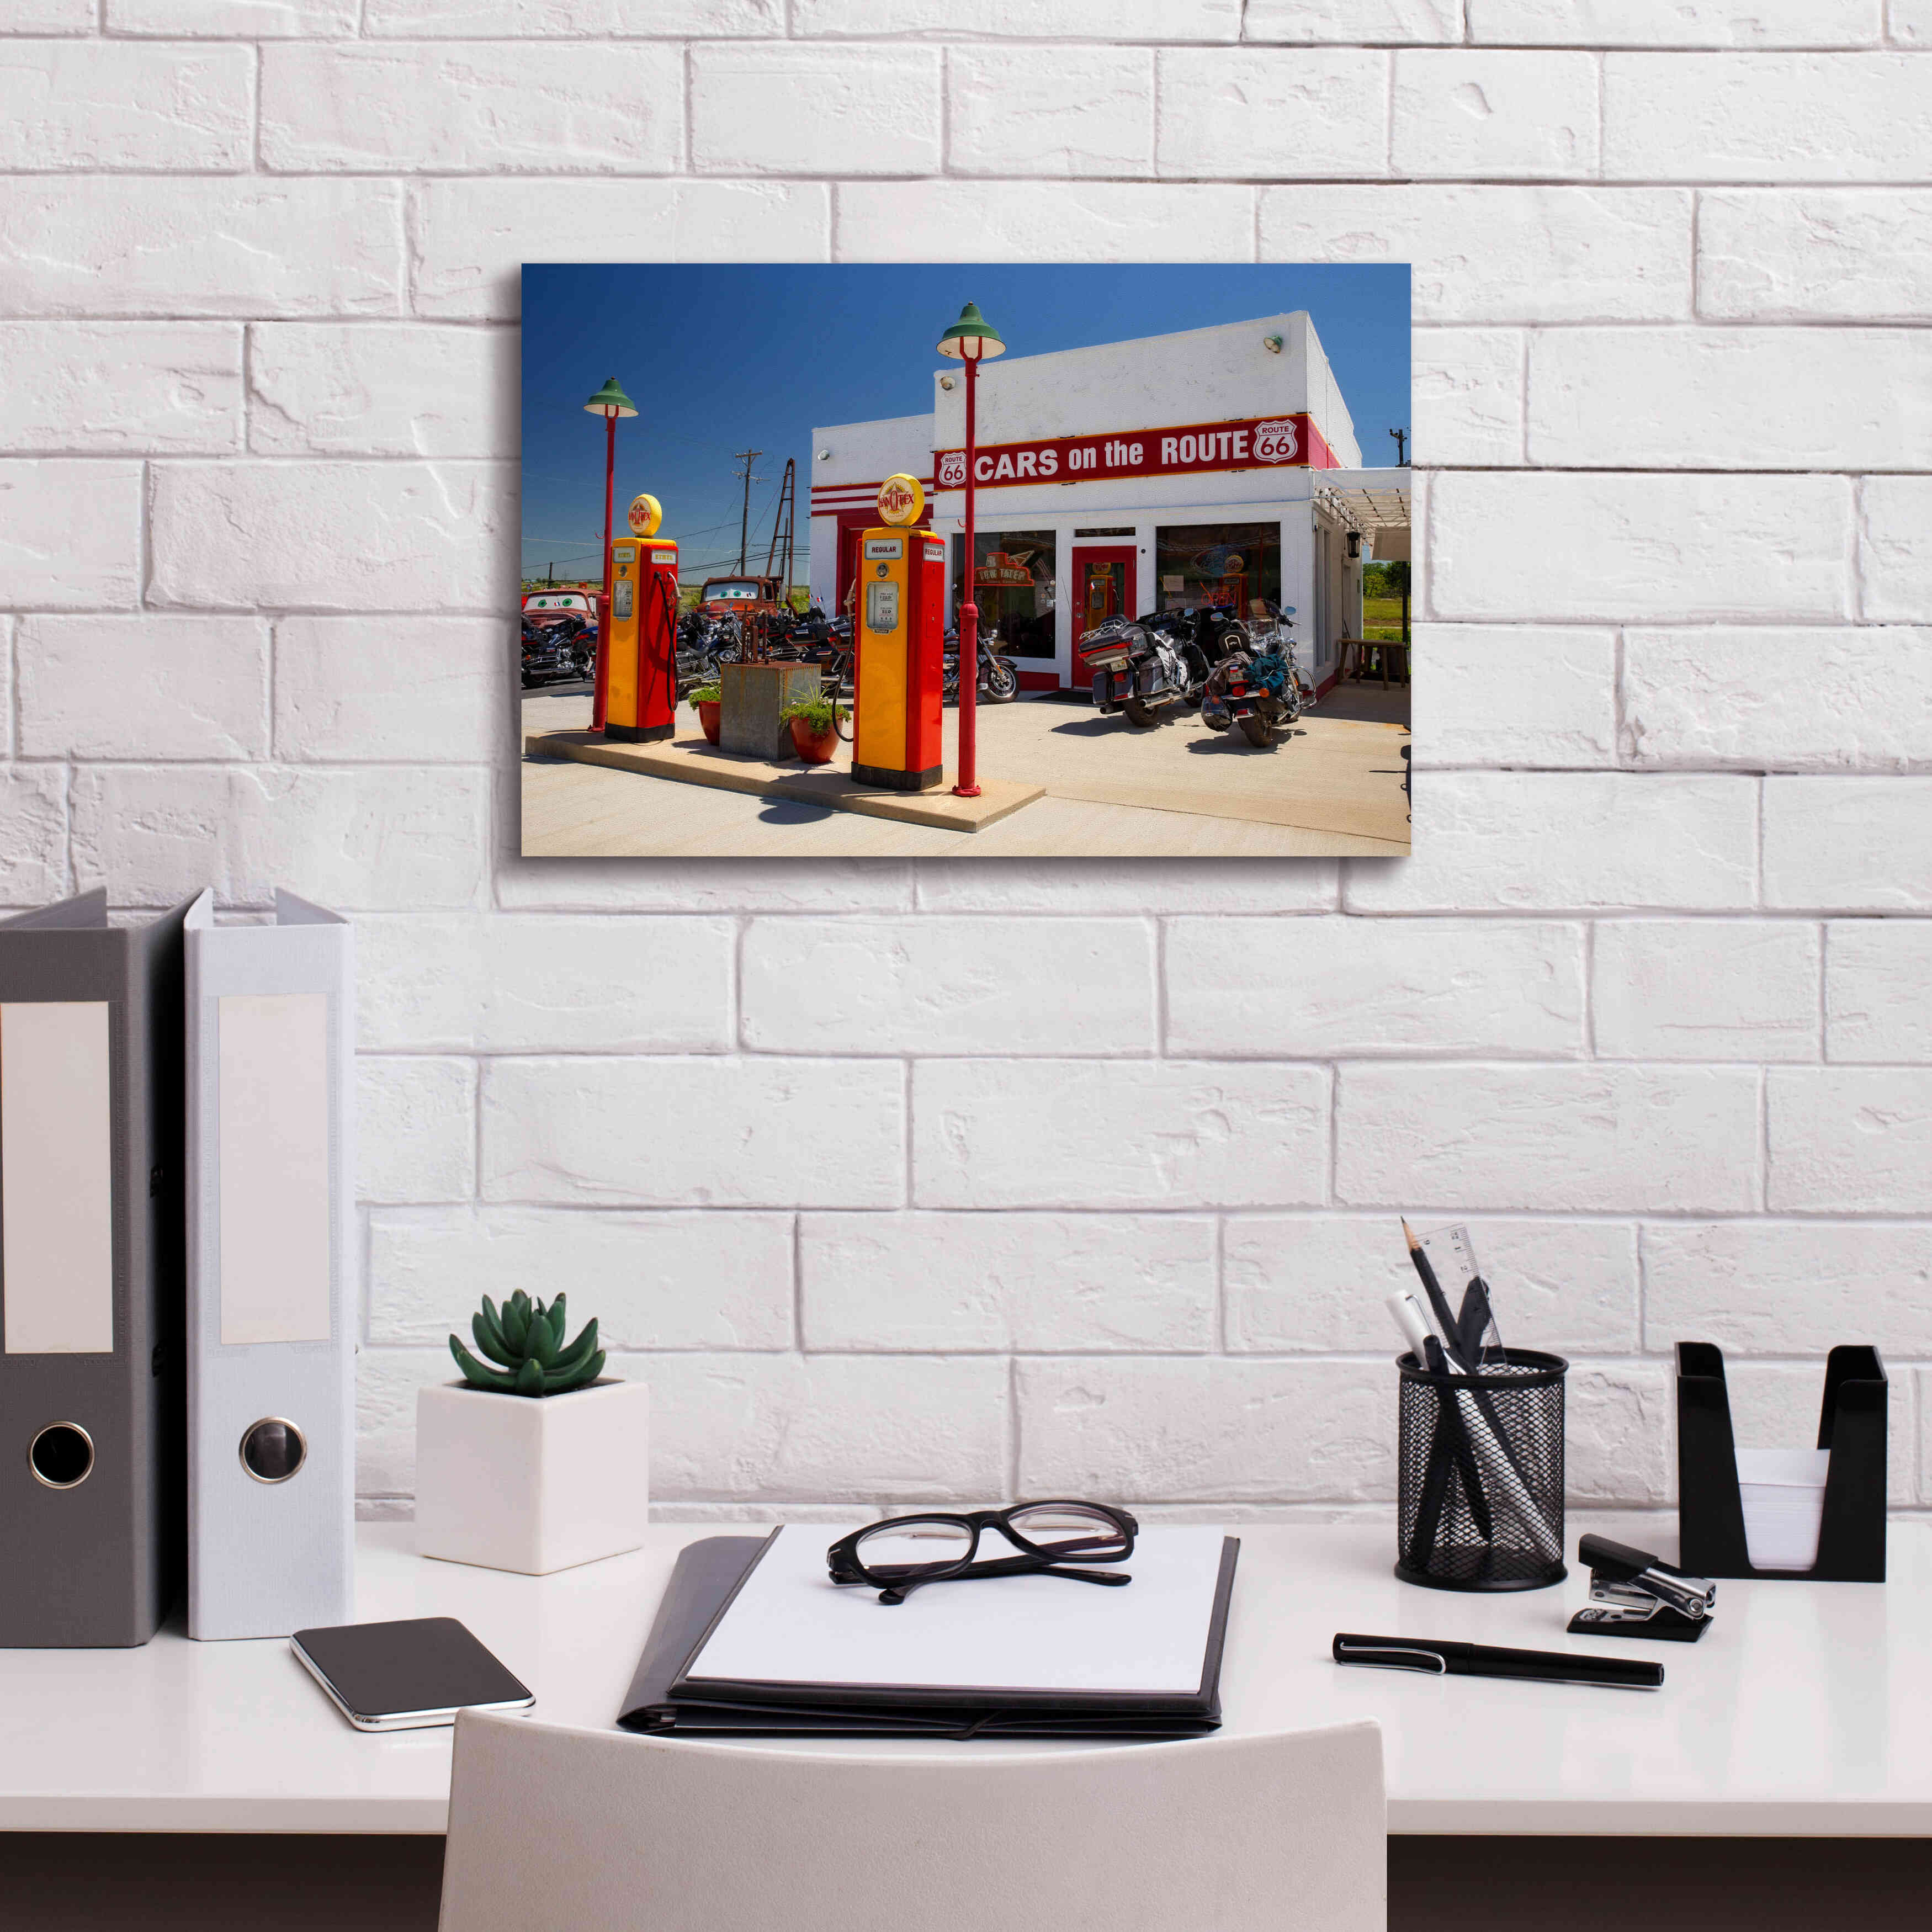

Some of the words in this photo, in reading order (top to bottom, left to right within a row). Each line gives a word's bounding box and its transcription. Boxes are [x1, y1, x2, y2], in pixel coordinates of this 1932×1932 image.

[1261, 426, 1289, 434] ROUTE
[1260, 436, 1289, 457] 66
[974, 449, 1058, 481] CARS
[1068, 447, 1097, 470] on
[1104, 440, 1143, 468] the
[1161, 429, 1249, 465] ROUTE
[944, 465, 963, 481] 66
[925, 548, 942, 556] REGULAR
